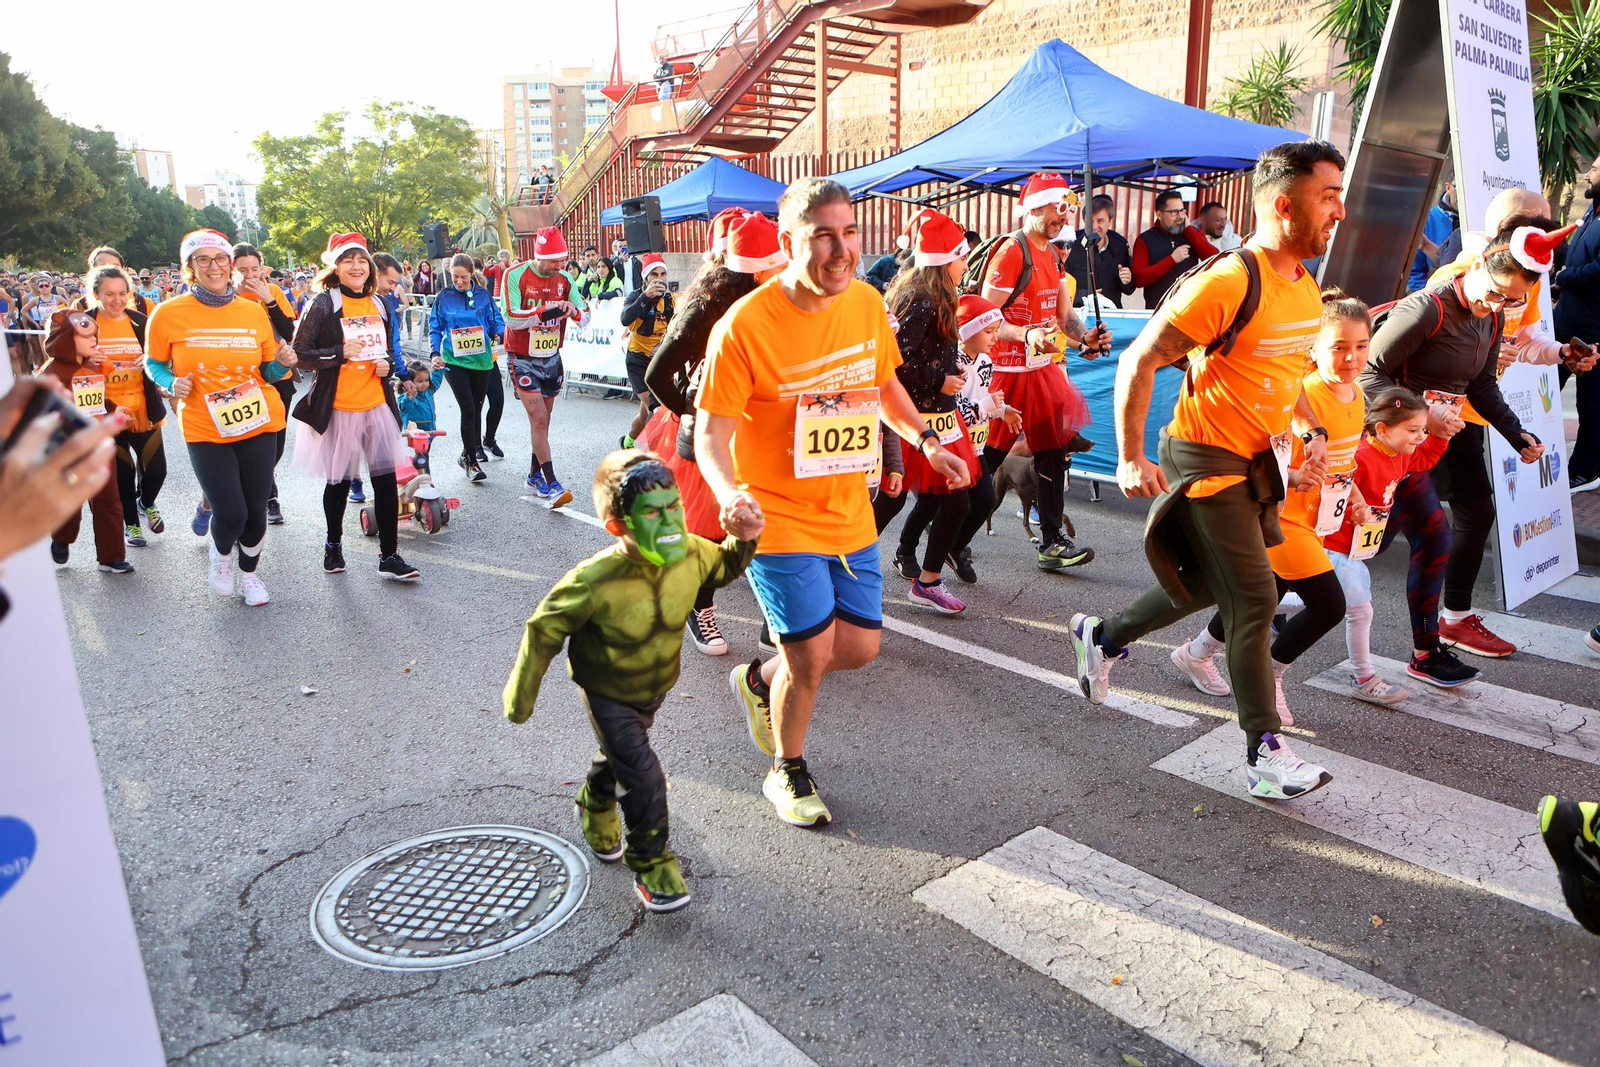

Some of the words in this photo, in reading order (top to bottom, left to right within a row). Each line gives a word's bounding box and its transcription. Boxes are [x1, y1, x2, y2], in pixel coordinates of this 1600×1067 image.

[1484, 0, 1522, 25] CARRERA
[1459, 13, 1478, 37] SAN
[1480, 22, 1522, 56] SILVESTRE
[1455, 39, 1488, 68] PALMA
[1489, 53, 1530, 83] PALMILLA
[458, 339, 483, 349] 1075
[843, 371, 875, 388] PALMILL
[78, 393, 103, 407] 1028
[221, 400, 261, 426] 1037
[926, 412, 956, 432] 100
[808, 425, 871, 454] 1023
[1334, 499, 1346, 517] 8
